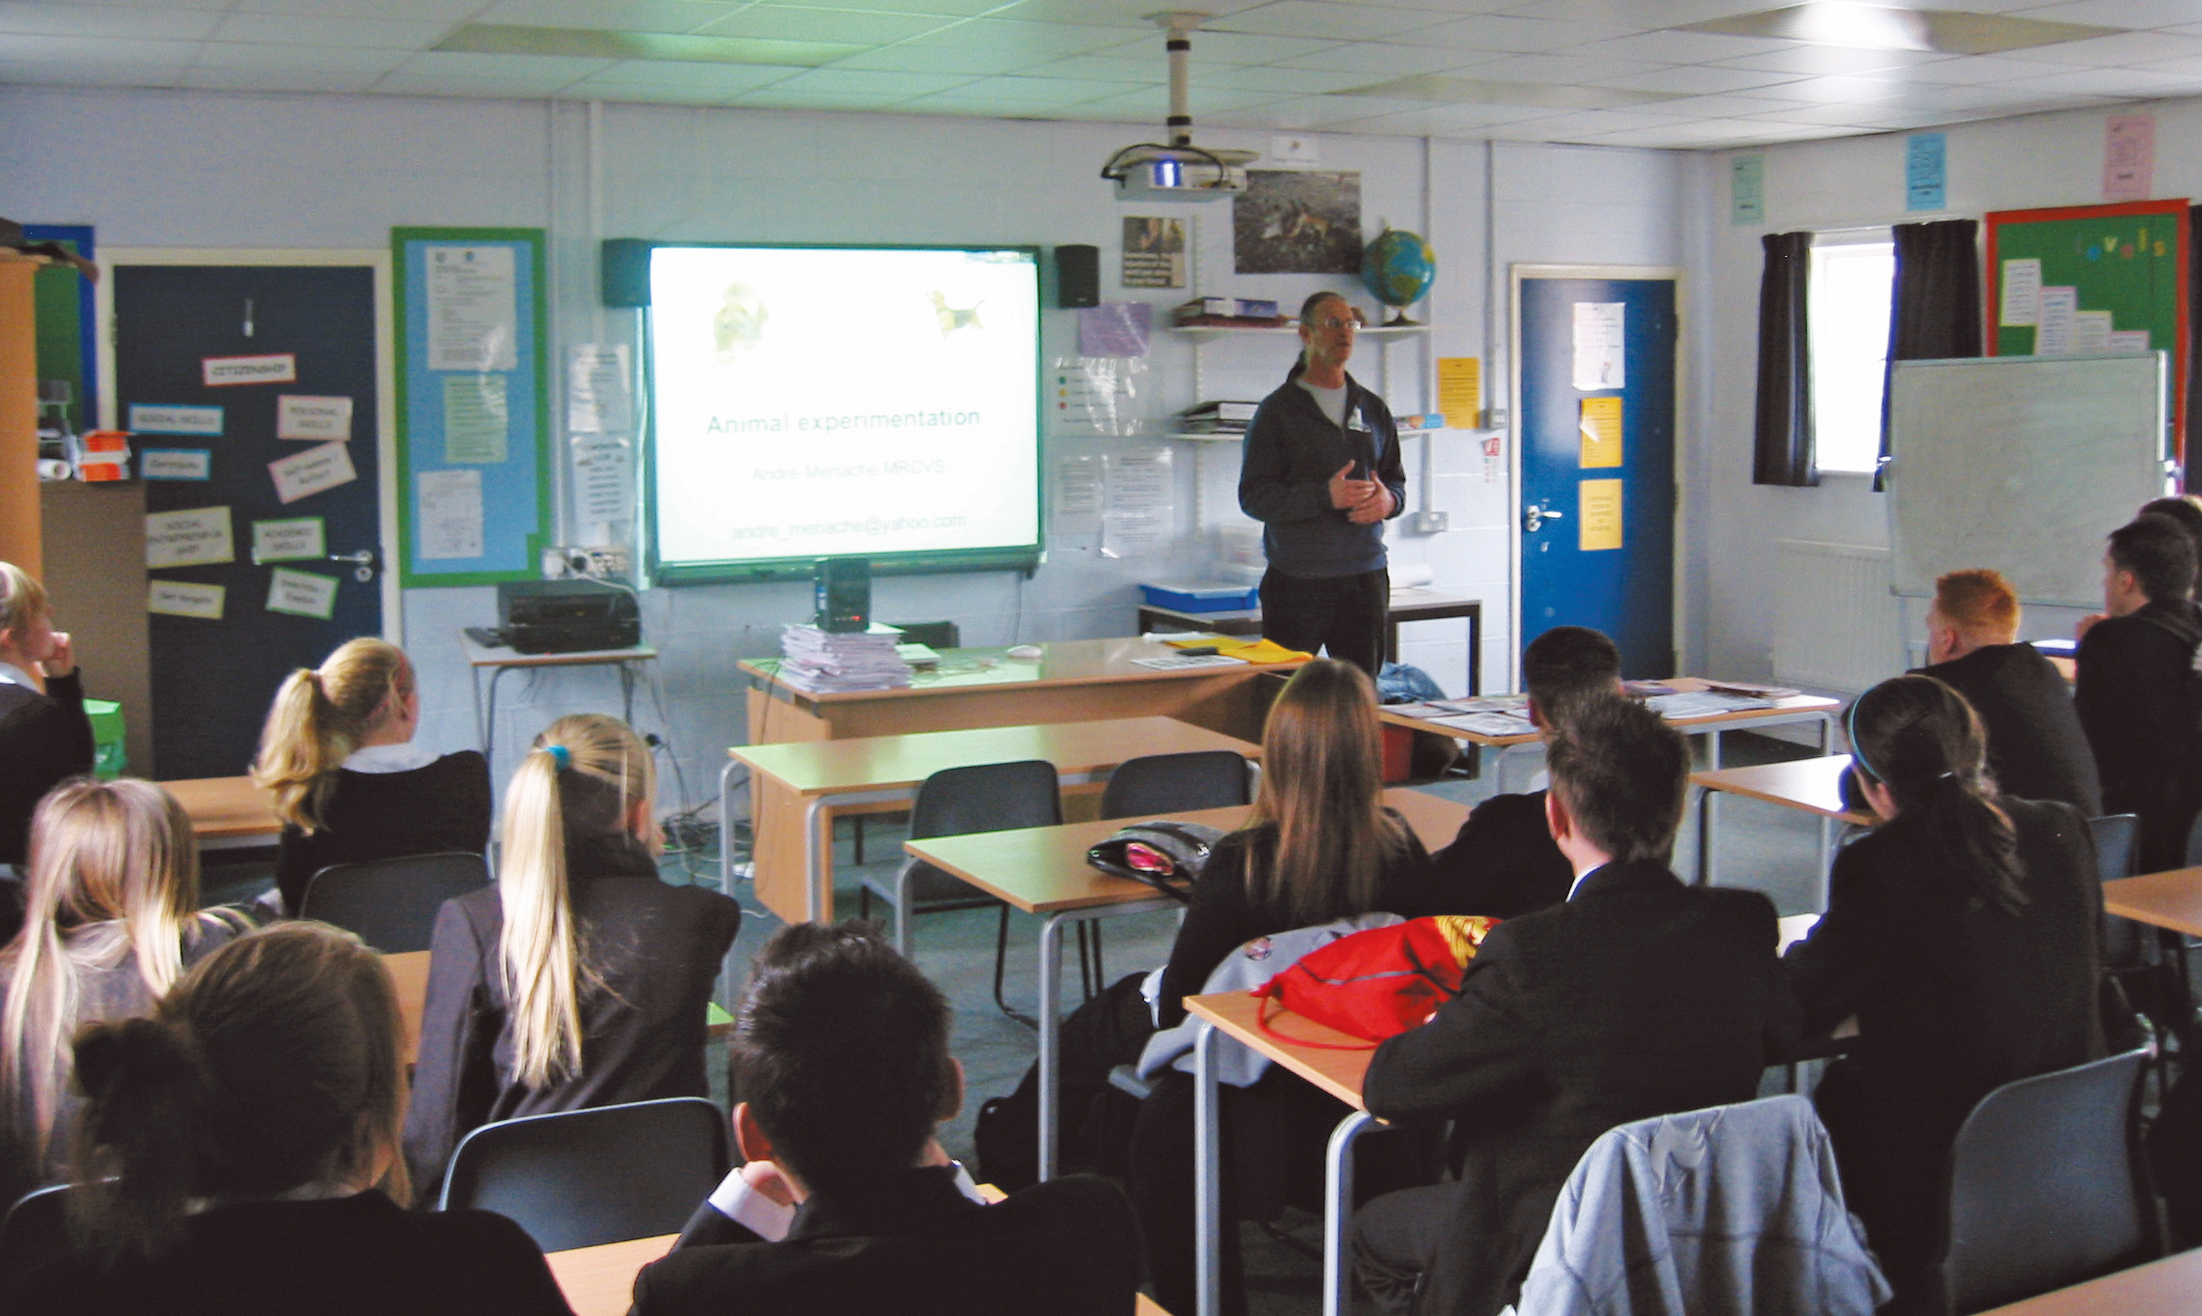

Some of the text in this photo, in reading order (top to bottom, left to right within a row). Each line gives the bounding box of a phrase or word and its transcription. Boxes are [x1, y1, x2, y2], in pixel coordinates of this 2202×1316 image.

[706, 409, 981, 435] Animal experimentation
[752, 458, 945, 481] Andre Menache MRCVS
[732, 514, 967, 541] andre_menache@yahoo.com
